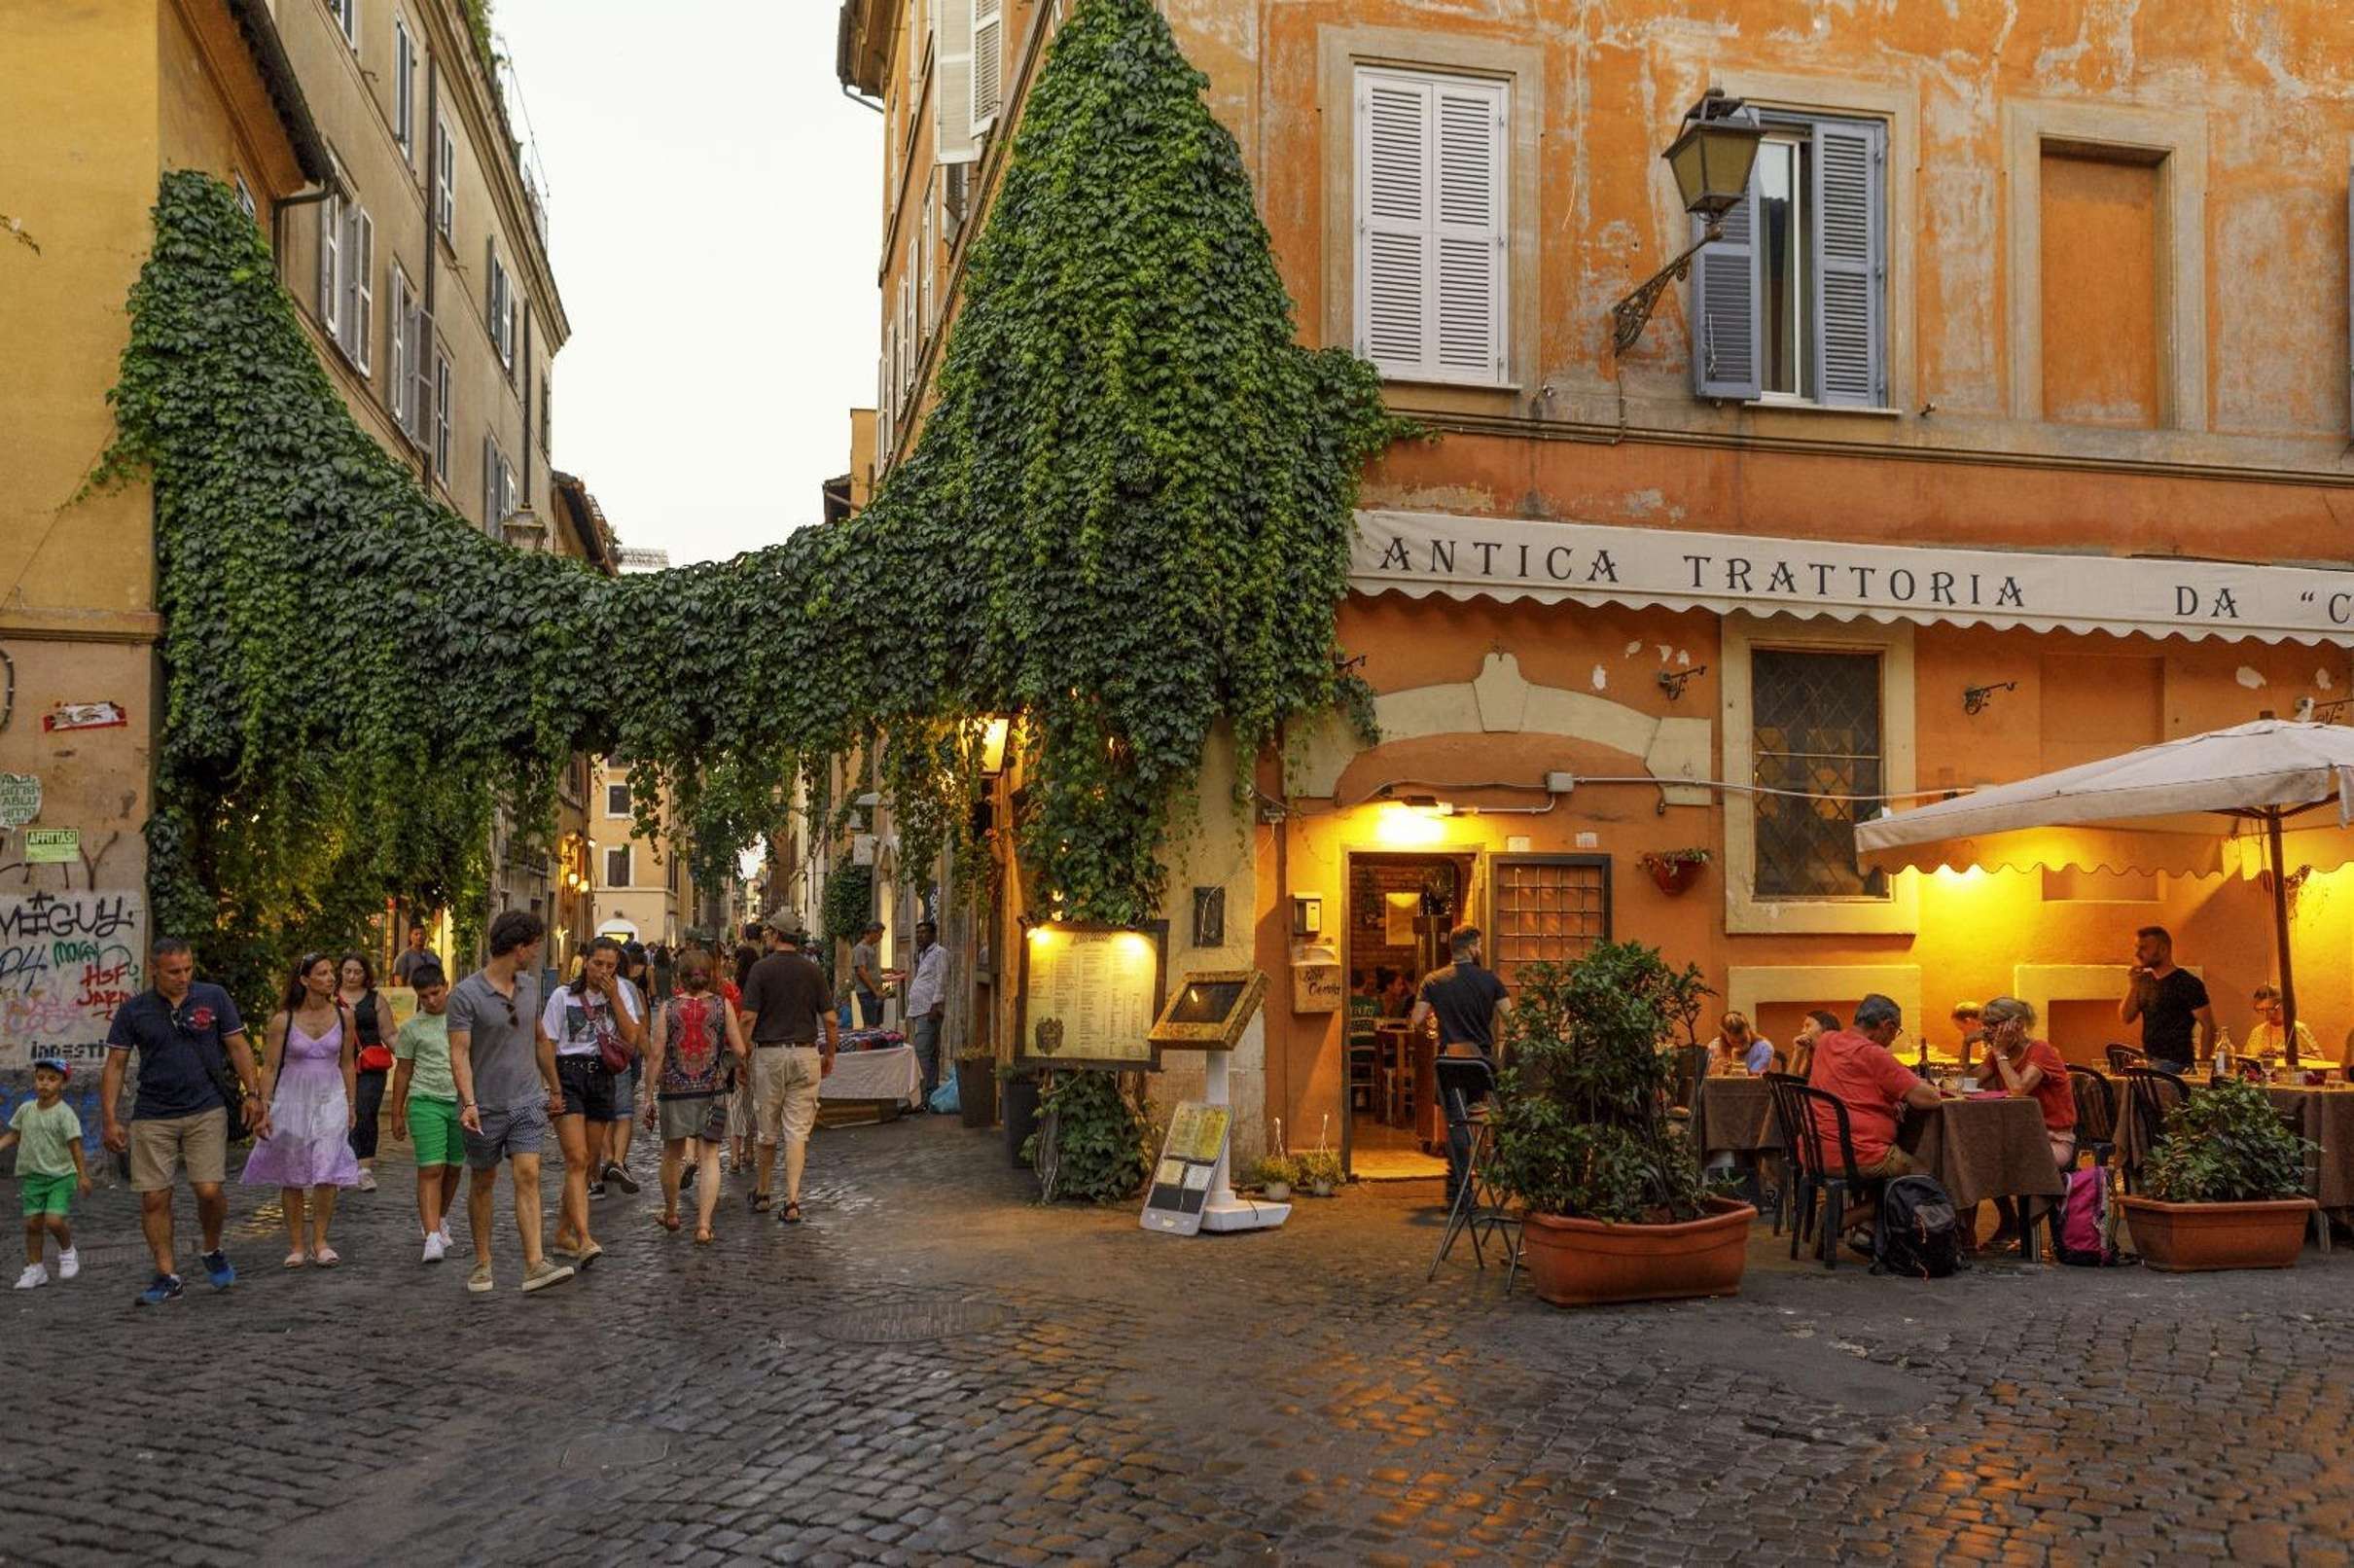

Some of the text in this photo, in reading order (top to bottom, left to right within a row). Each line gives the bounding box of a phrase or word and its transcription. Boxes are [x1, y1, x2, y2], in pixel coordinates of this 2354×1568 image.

[1379, 537, 1619, 583] ANTICA
[1683, 554, 2024, 607] TRATTORIA
[2175, 586, 2239, 619] DA
